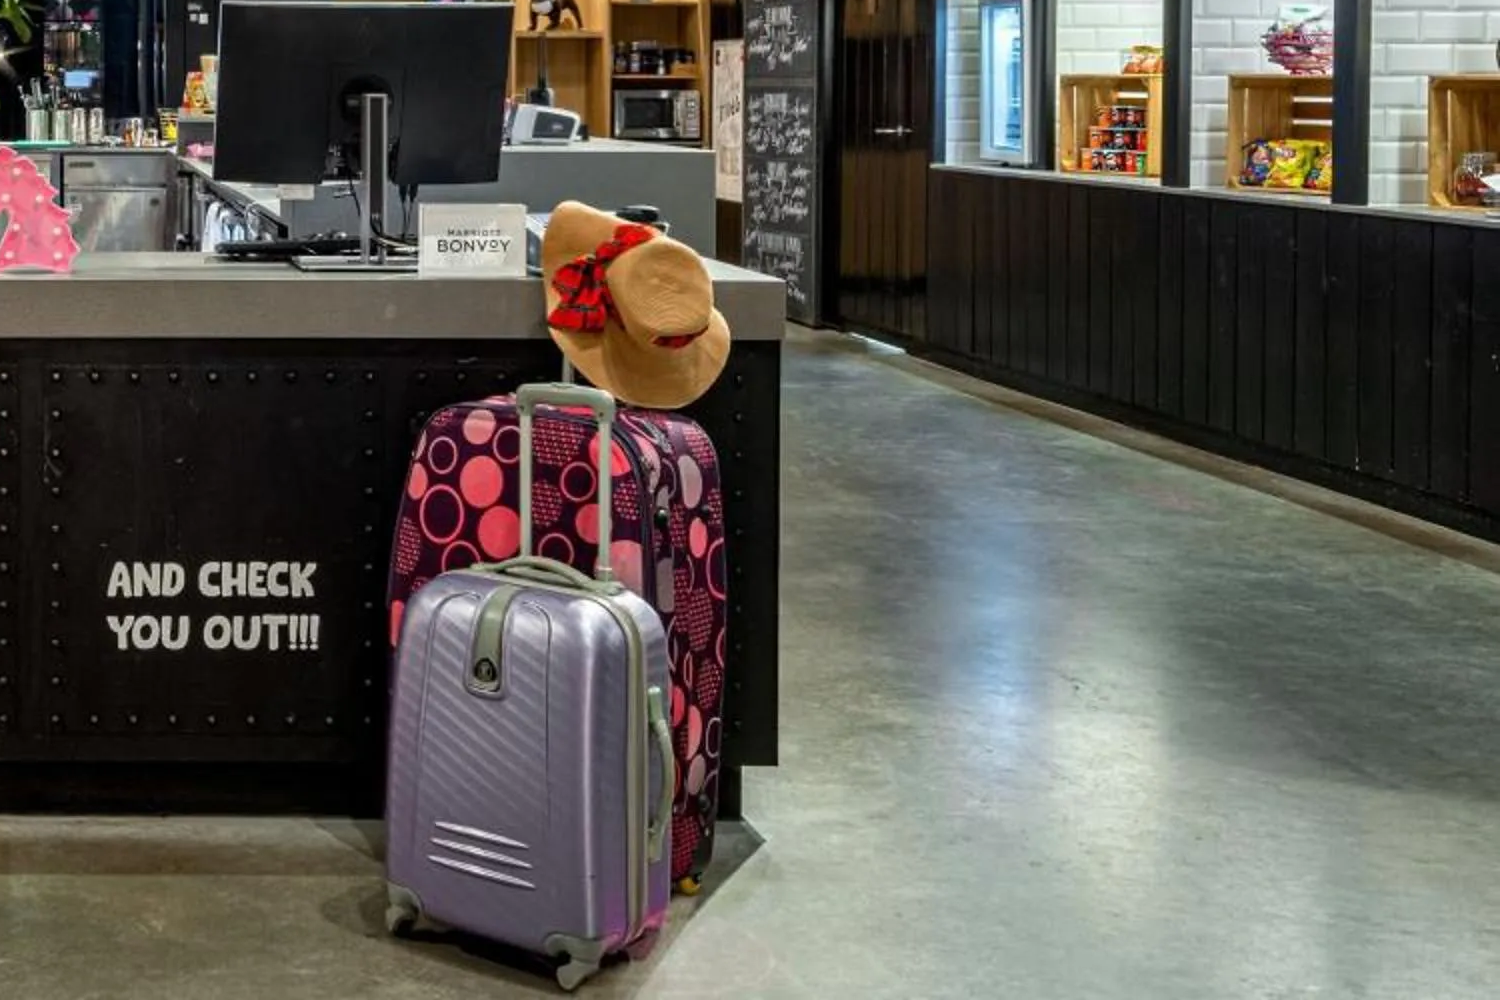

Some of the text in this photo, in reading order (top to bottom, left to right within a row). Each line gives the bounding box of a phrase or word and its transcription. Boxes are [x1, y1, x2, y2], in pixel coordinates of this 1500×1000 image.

[107, 561, 318, 598] AND CHECK
[106, 614, 321, 651] YOU OUT!!!
